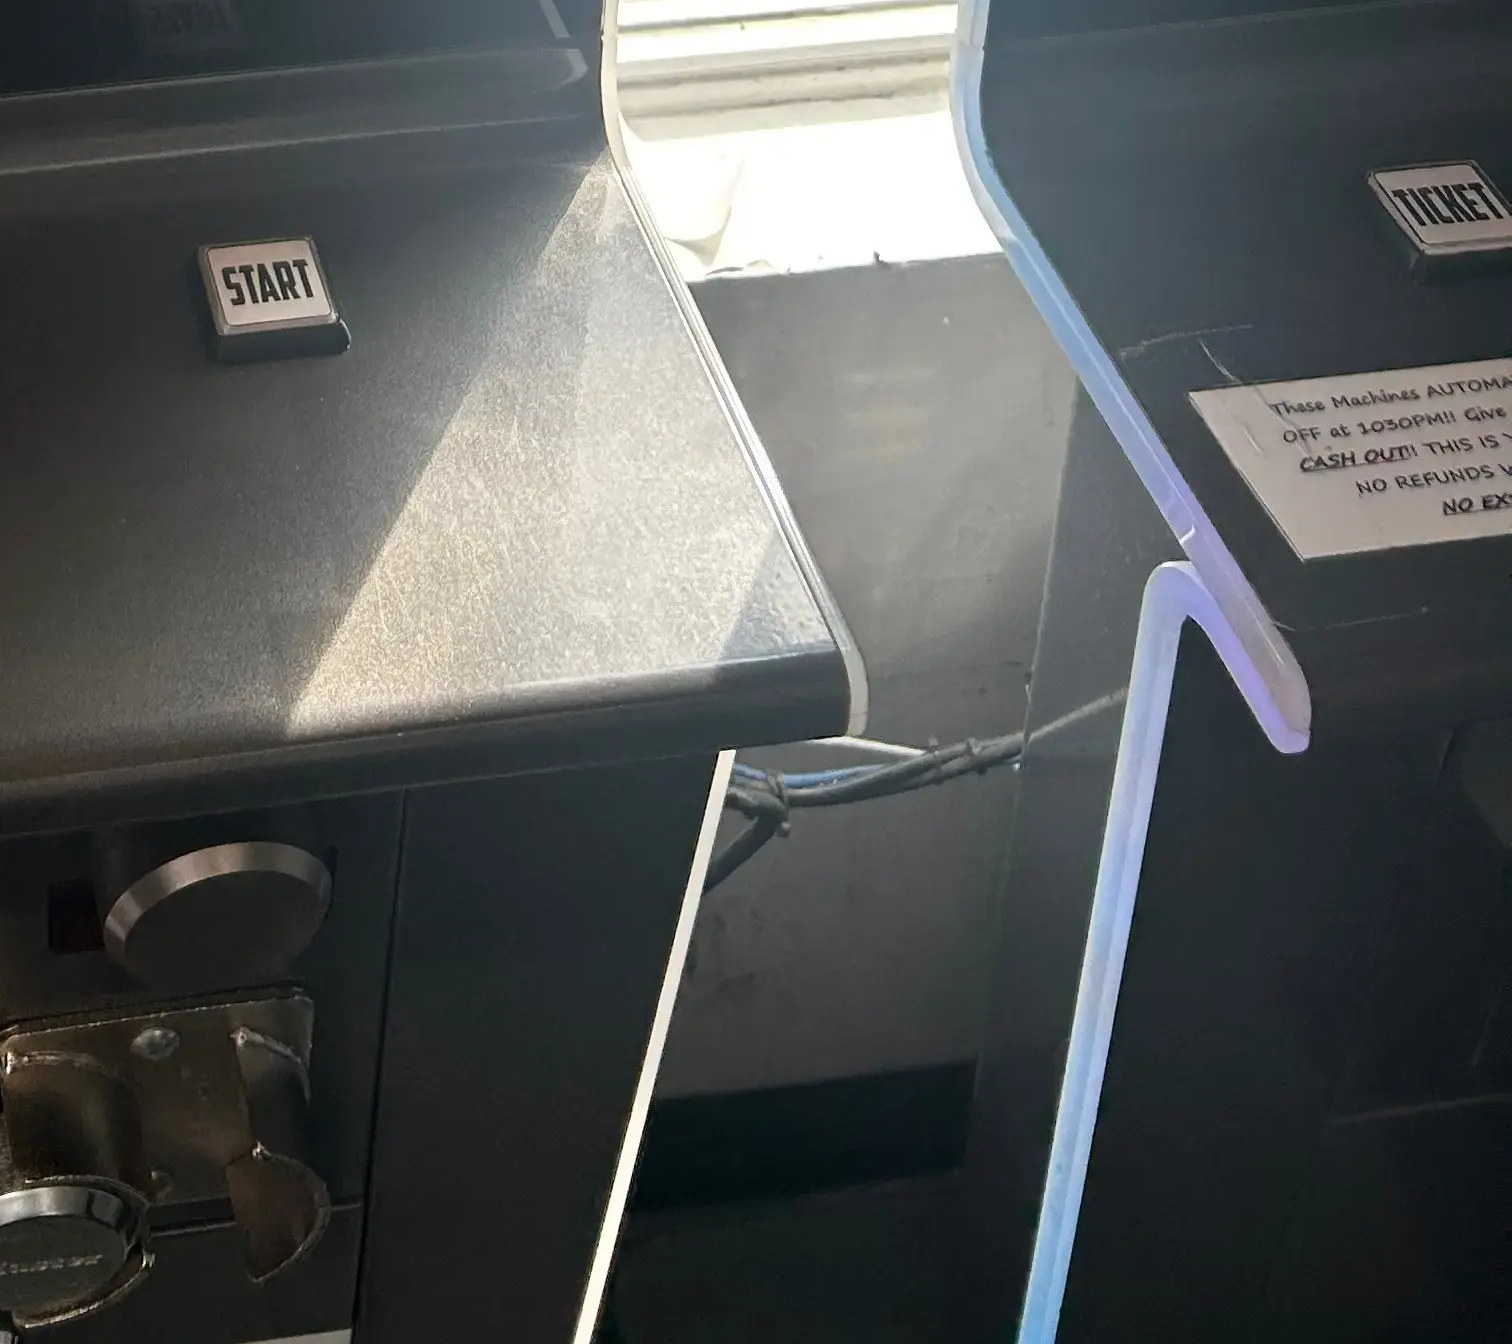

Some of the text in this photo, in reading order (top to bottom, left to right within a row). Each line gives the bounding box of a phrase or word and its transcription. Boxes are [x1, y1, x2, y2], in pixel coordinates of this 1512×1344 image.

[1393, 182, 1503, 227] TICKET
[222, 258, 314, 305] START
[1269, 400, 1325, 416] These
[1332, 388, 1420, 409] Machines
[1283, 405, 1506, 443] OFF at 1030PM!! Give
[1300, 451, 1356, 472] CASH
[1423, 437, 1474, 456] THIS
[1478, 434, 1501, 450] IS
[1356, 478, 1388, 494] NO
[1395, 464, 1495, 489] REFUNDS
[1442, 496, 1474, 515] NO
